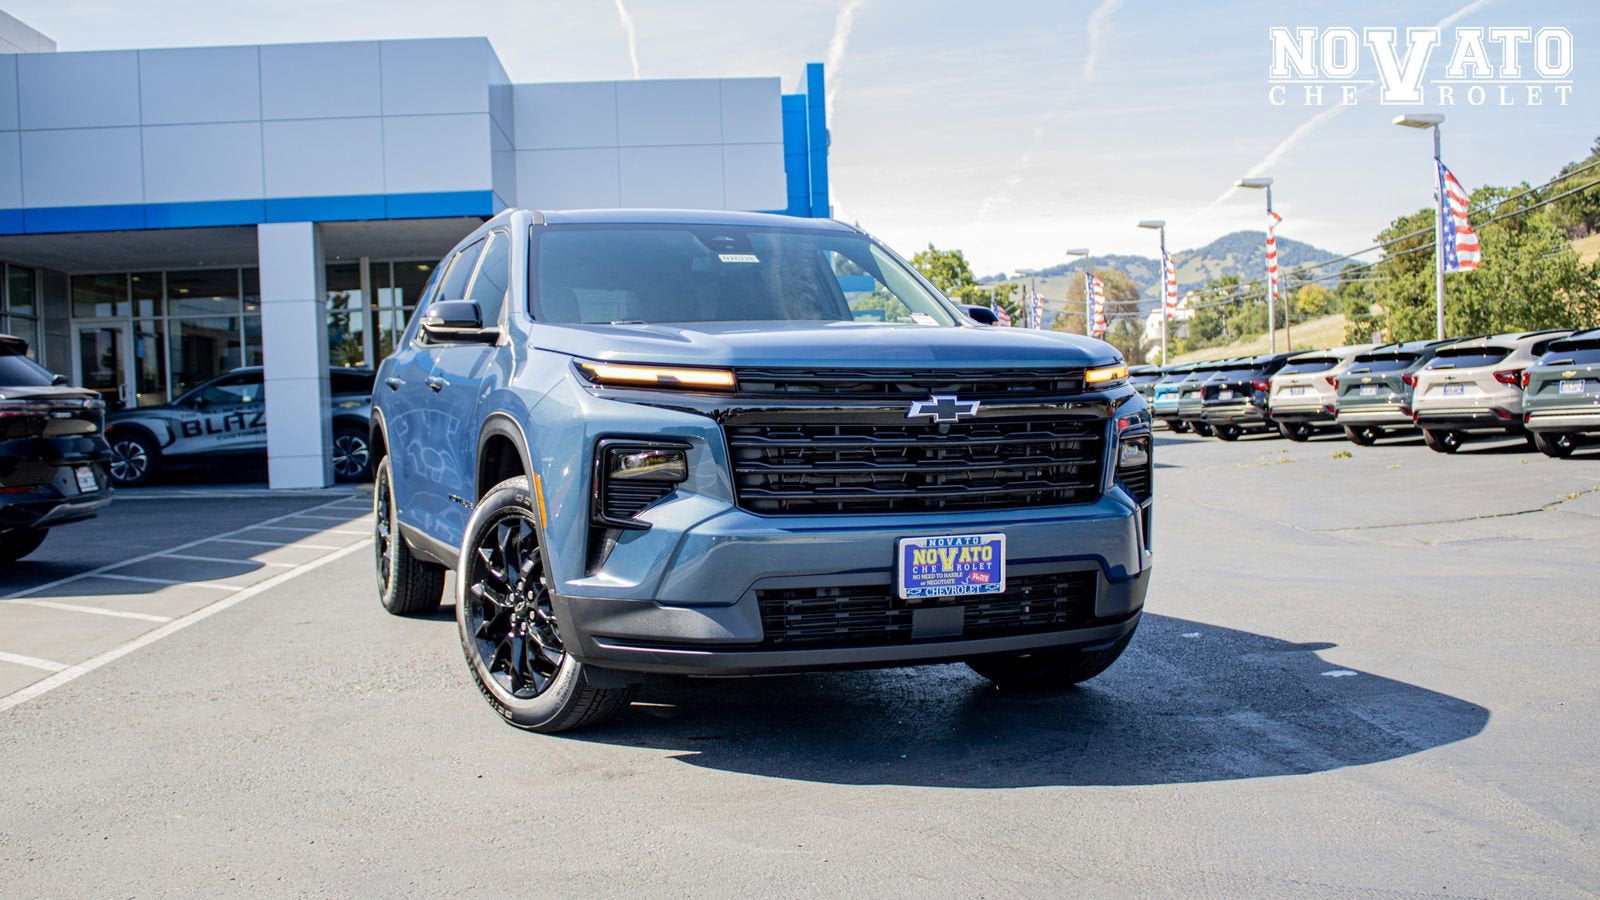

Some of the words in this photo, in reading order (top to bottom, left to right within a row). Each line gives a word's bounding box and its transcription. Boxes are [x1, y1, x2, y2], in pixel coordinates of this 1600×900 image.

[929, 537, 979, 546] NOVATO
[913, 547, 992, 572] NOVATO
[925, 585, 981, 596] CHEVROLET
